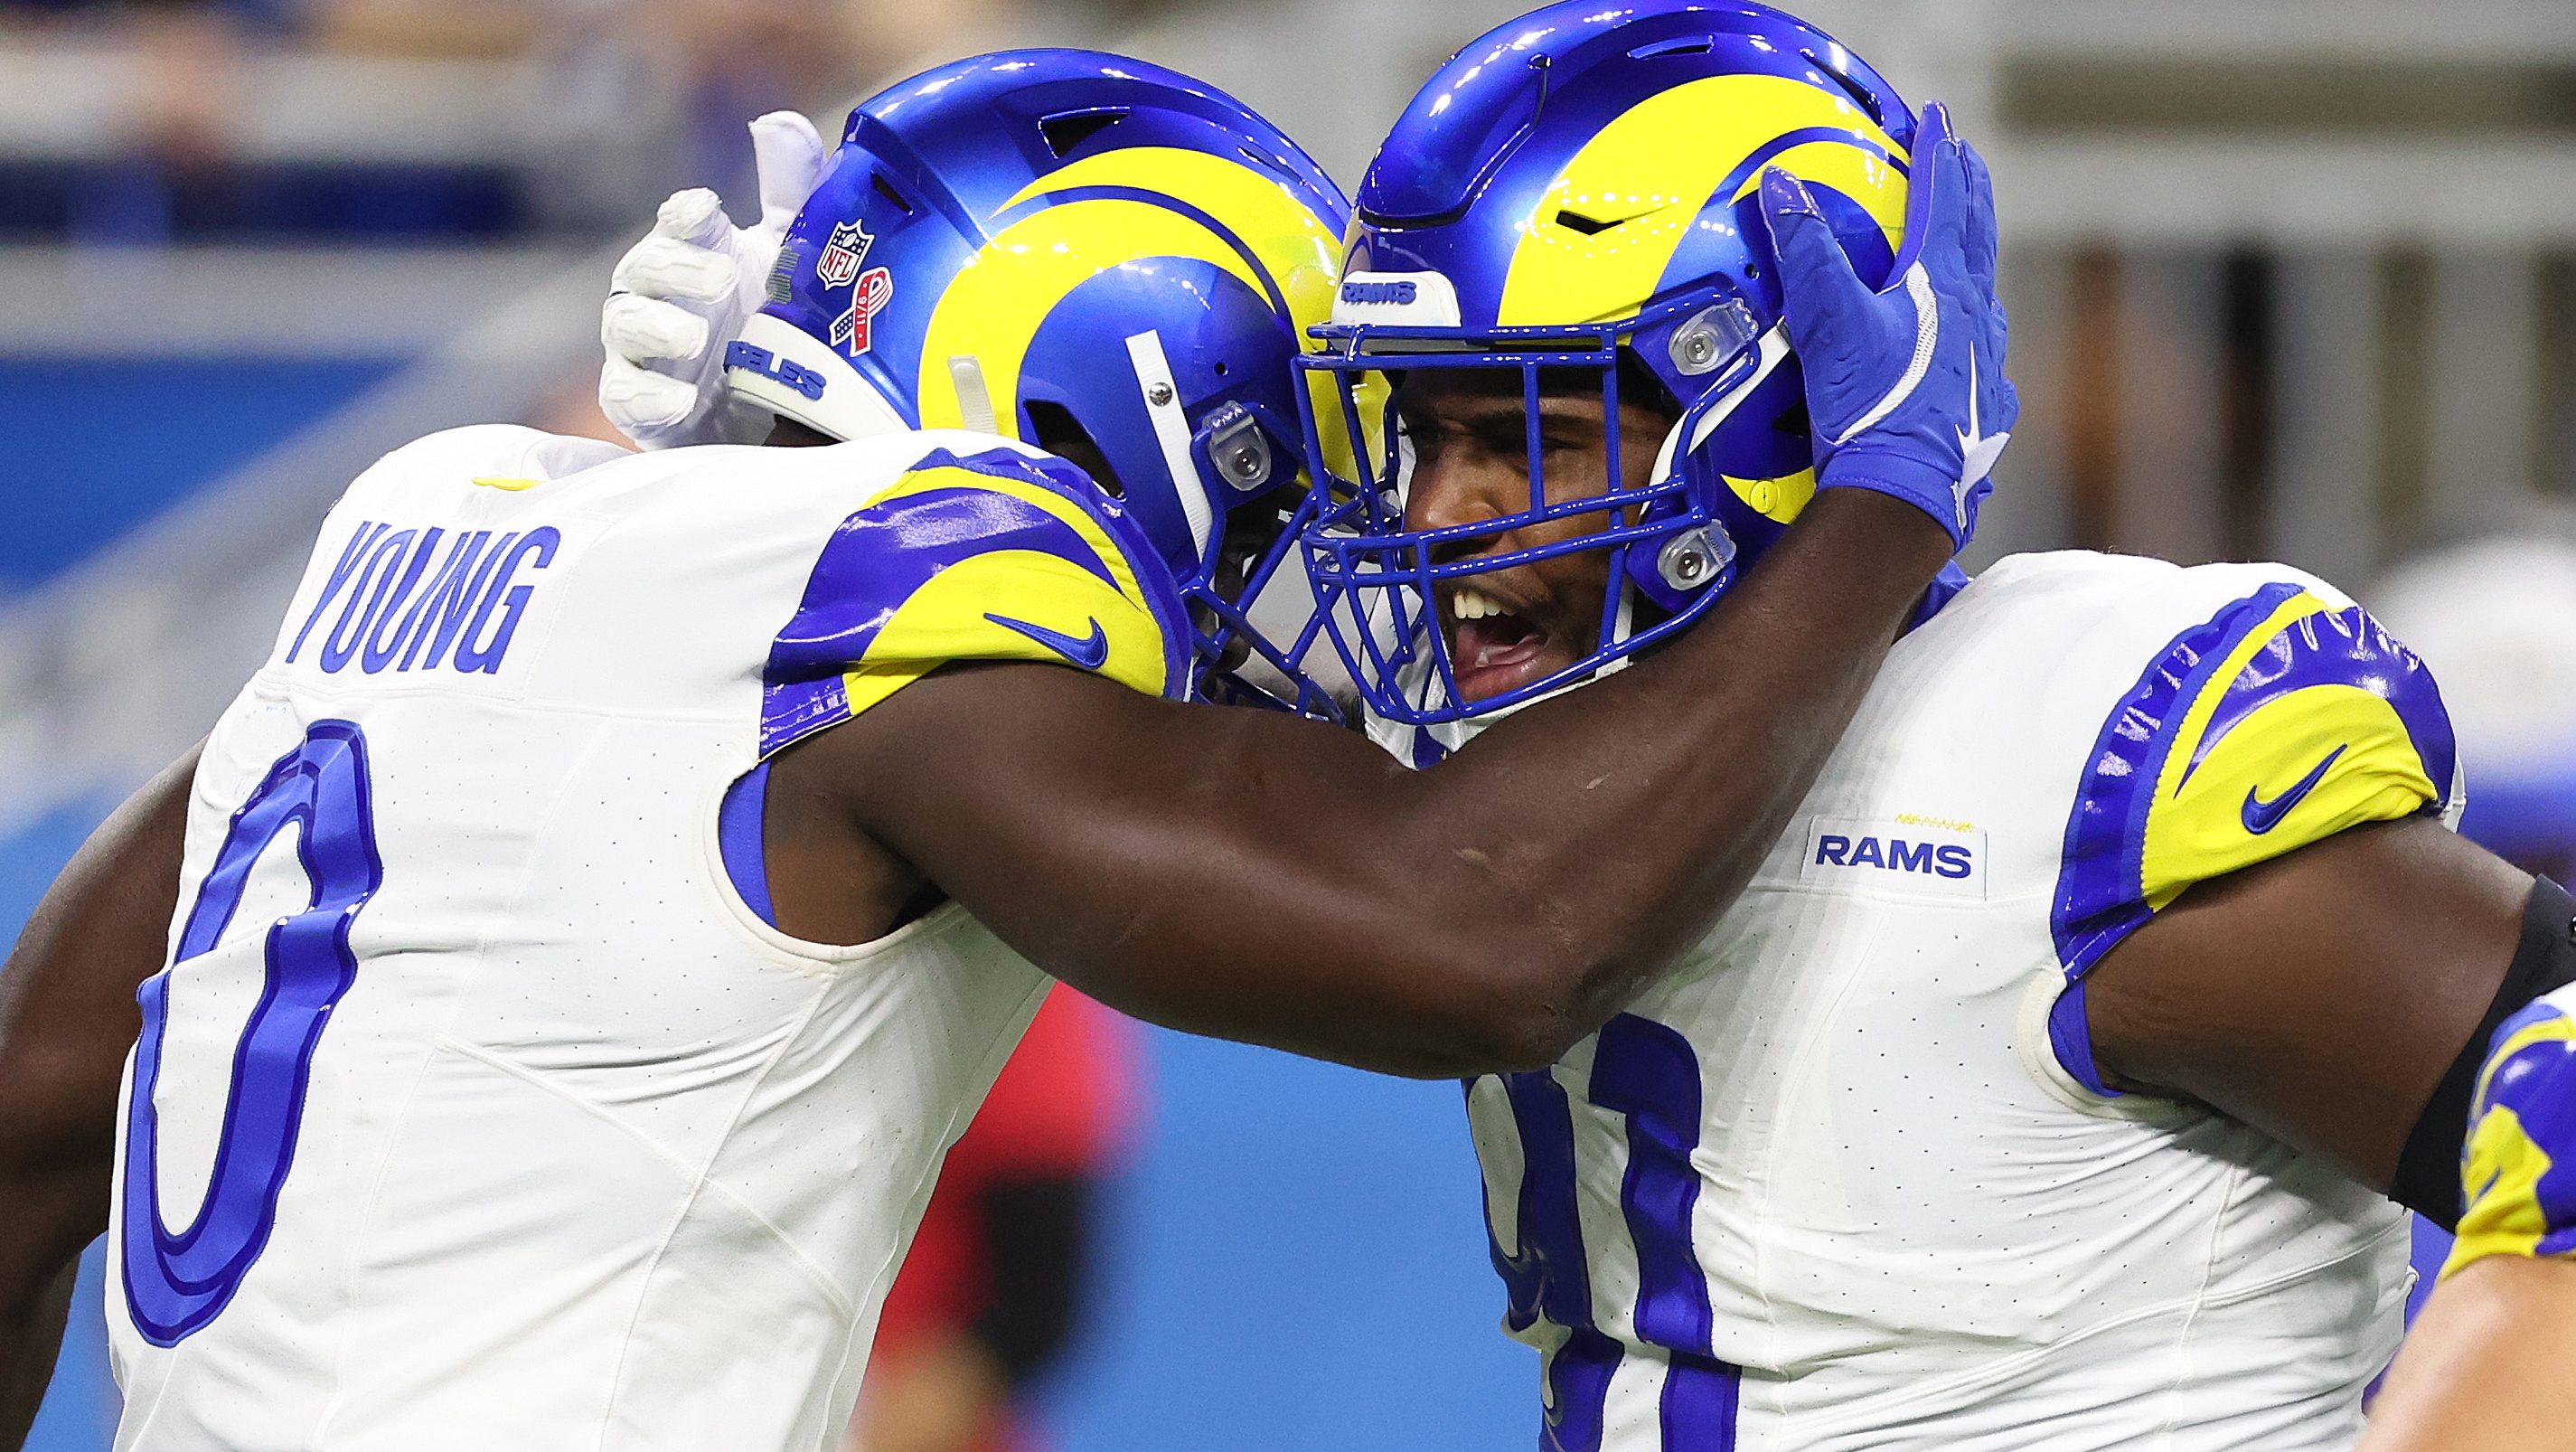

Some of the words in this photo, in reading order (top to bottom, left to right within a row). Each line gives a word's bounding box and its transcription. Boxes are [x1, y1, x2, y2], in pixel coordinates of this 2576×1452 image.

[823, 248, 853, 278] NFL
[856, 296, 868, 325] 9/11
[1341, 281, 1417, 305] RAMS
[285, 521, 561, 674] YOUNG
[1815, 834, 1972, 879] RAMS
[121, 718, 384, 1349] 0
[1462, 1012, 1743, 1452] 91
